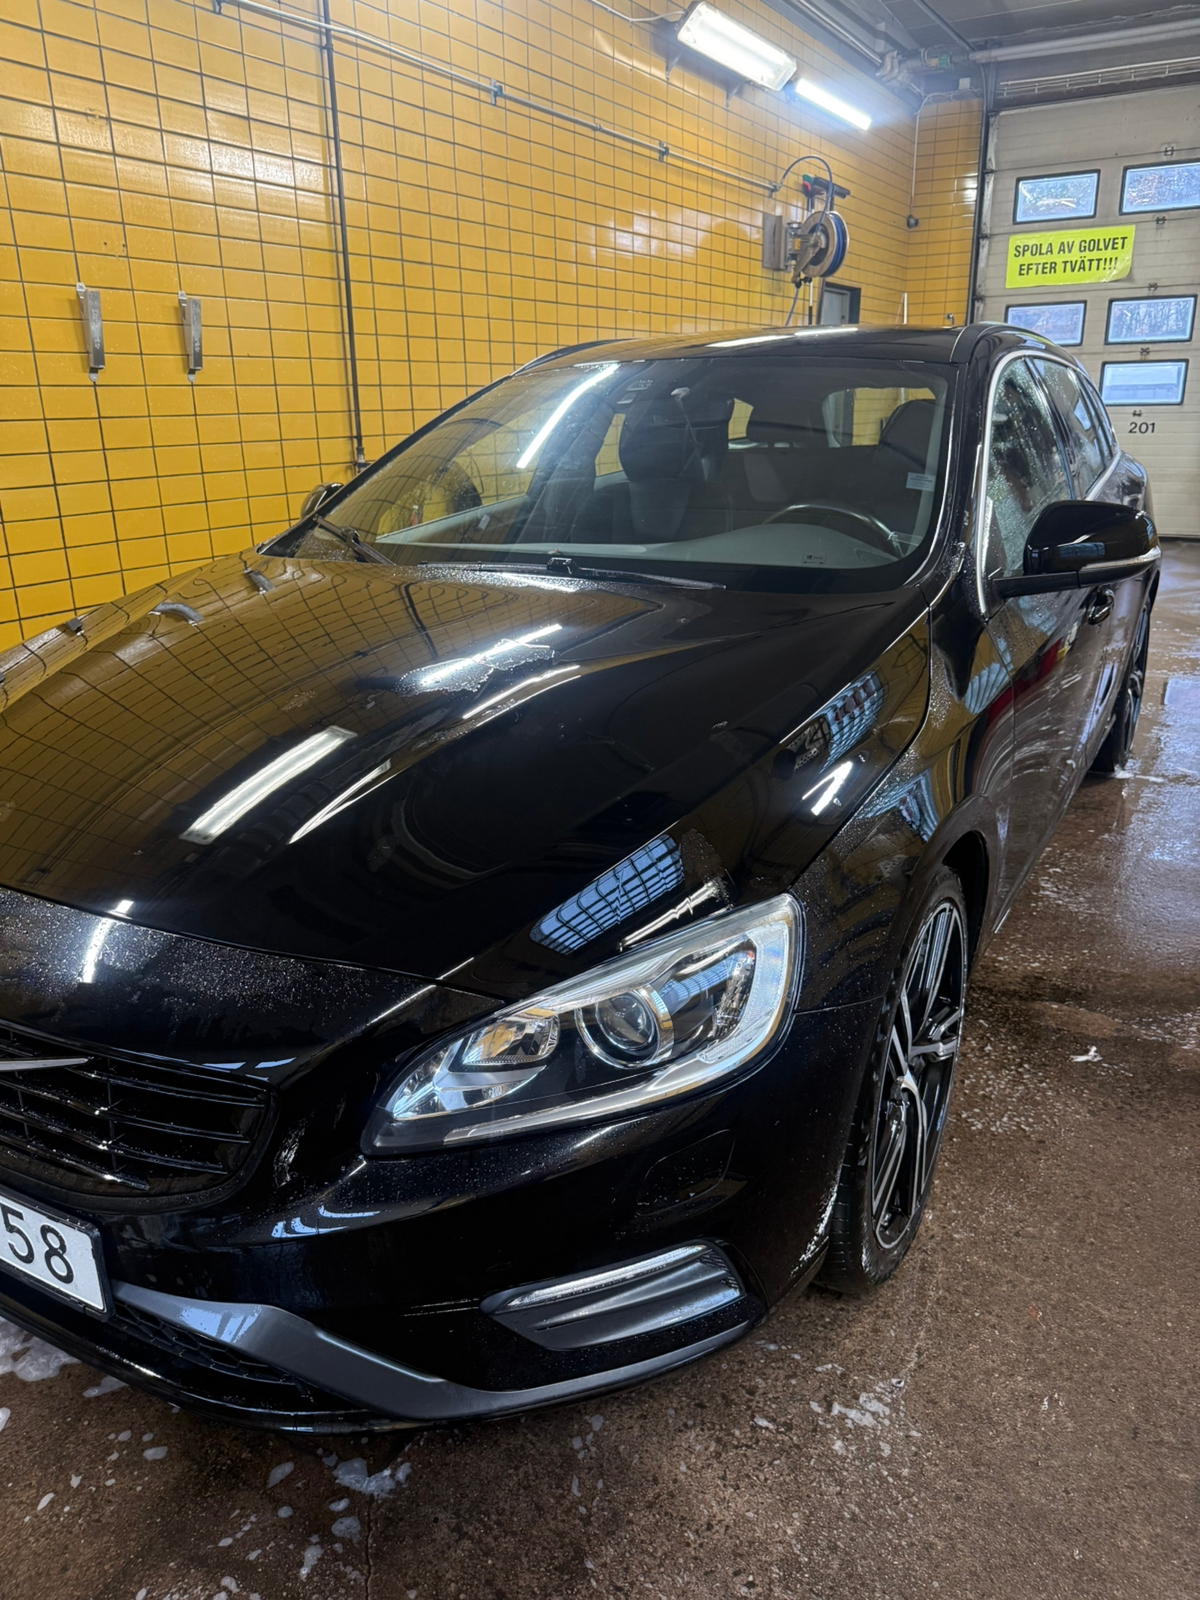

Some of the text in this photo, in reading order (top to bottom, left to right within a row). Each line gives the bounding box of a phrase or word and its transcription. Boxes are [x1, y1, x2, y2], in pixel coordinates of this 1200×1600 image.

[1014, 236, 1128, 258] SPOLA AV GOLVET
[1018, 256, 1118, 276] EFTER TVÄTT!!!
[1128, 421, 1155, 434] 201
[0, 1204, 74, 1285] 58
